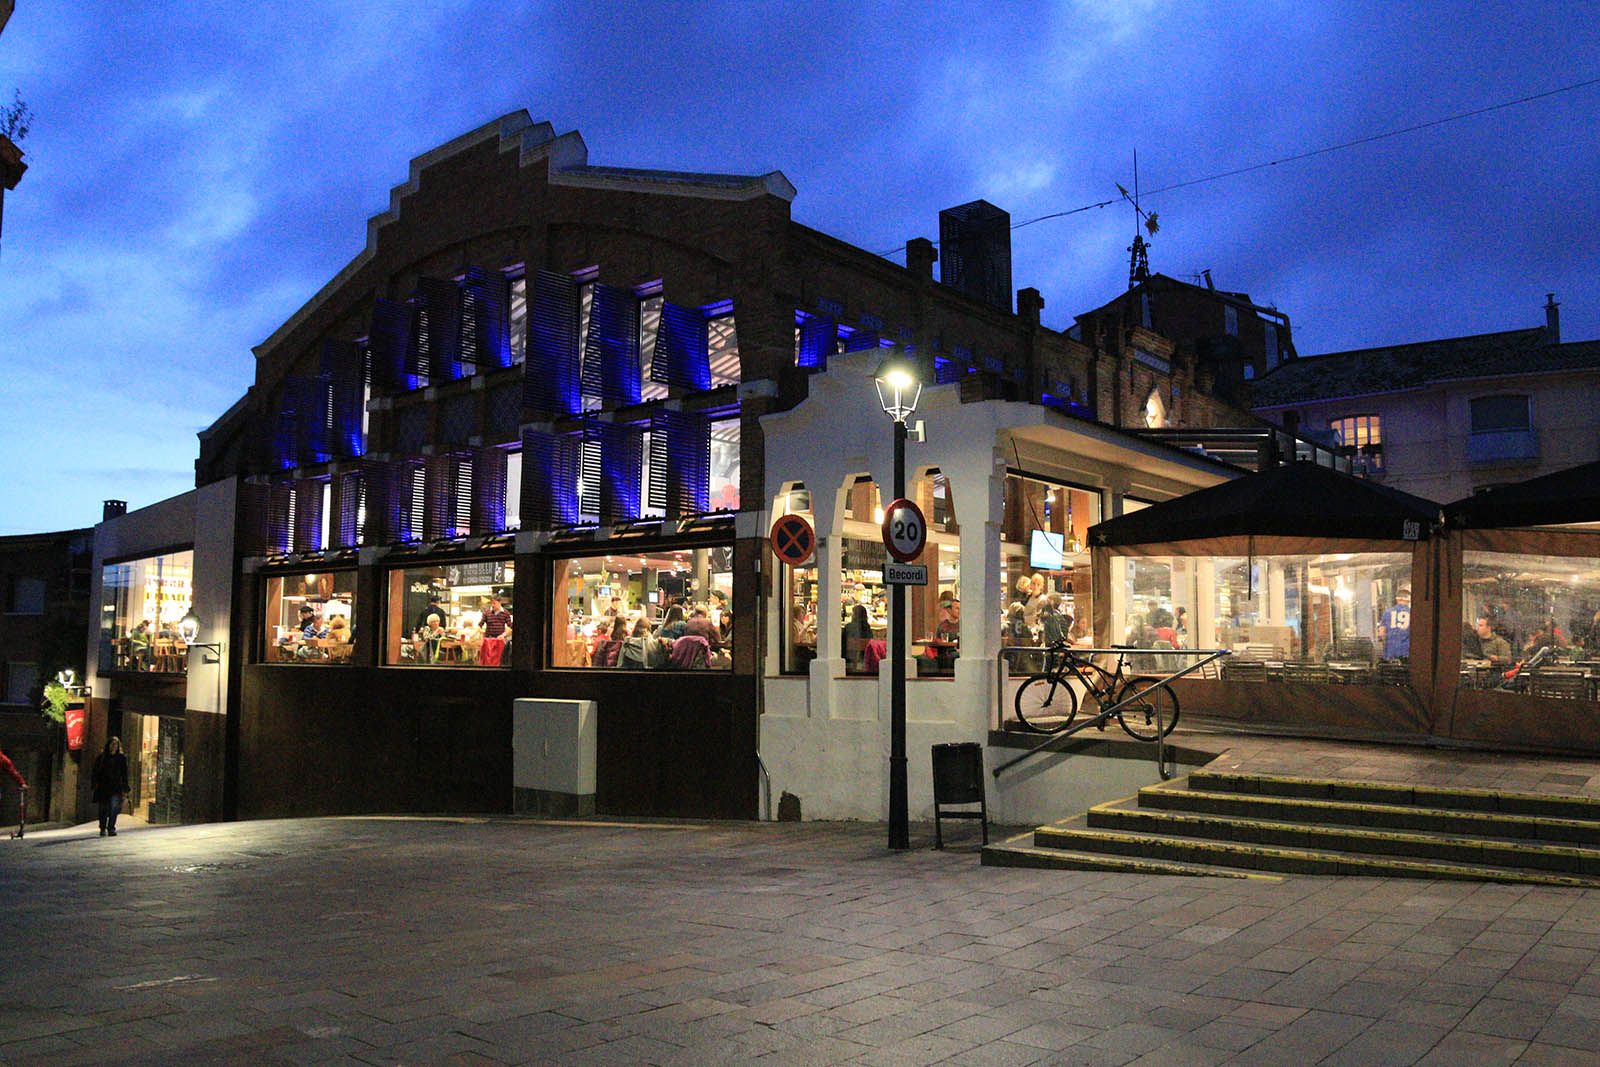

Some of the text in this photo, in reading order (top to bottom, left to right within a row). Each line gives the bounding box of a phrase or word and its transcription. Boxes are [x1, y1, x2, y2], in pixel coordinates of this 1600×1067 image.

[894, 519, 918, 541] 20
[888, 567, 923, 580] Becordi
[1390, 609, 1411, 630] 19
